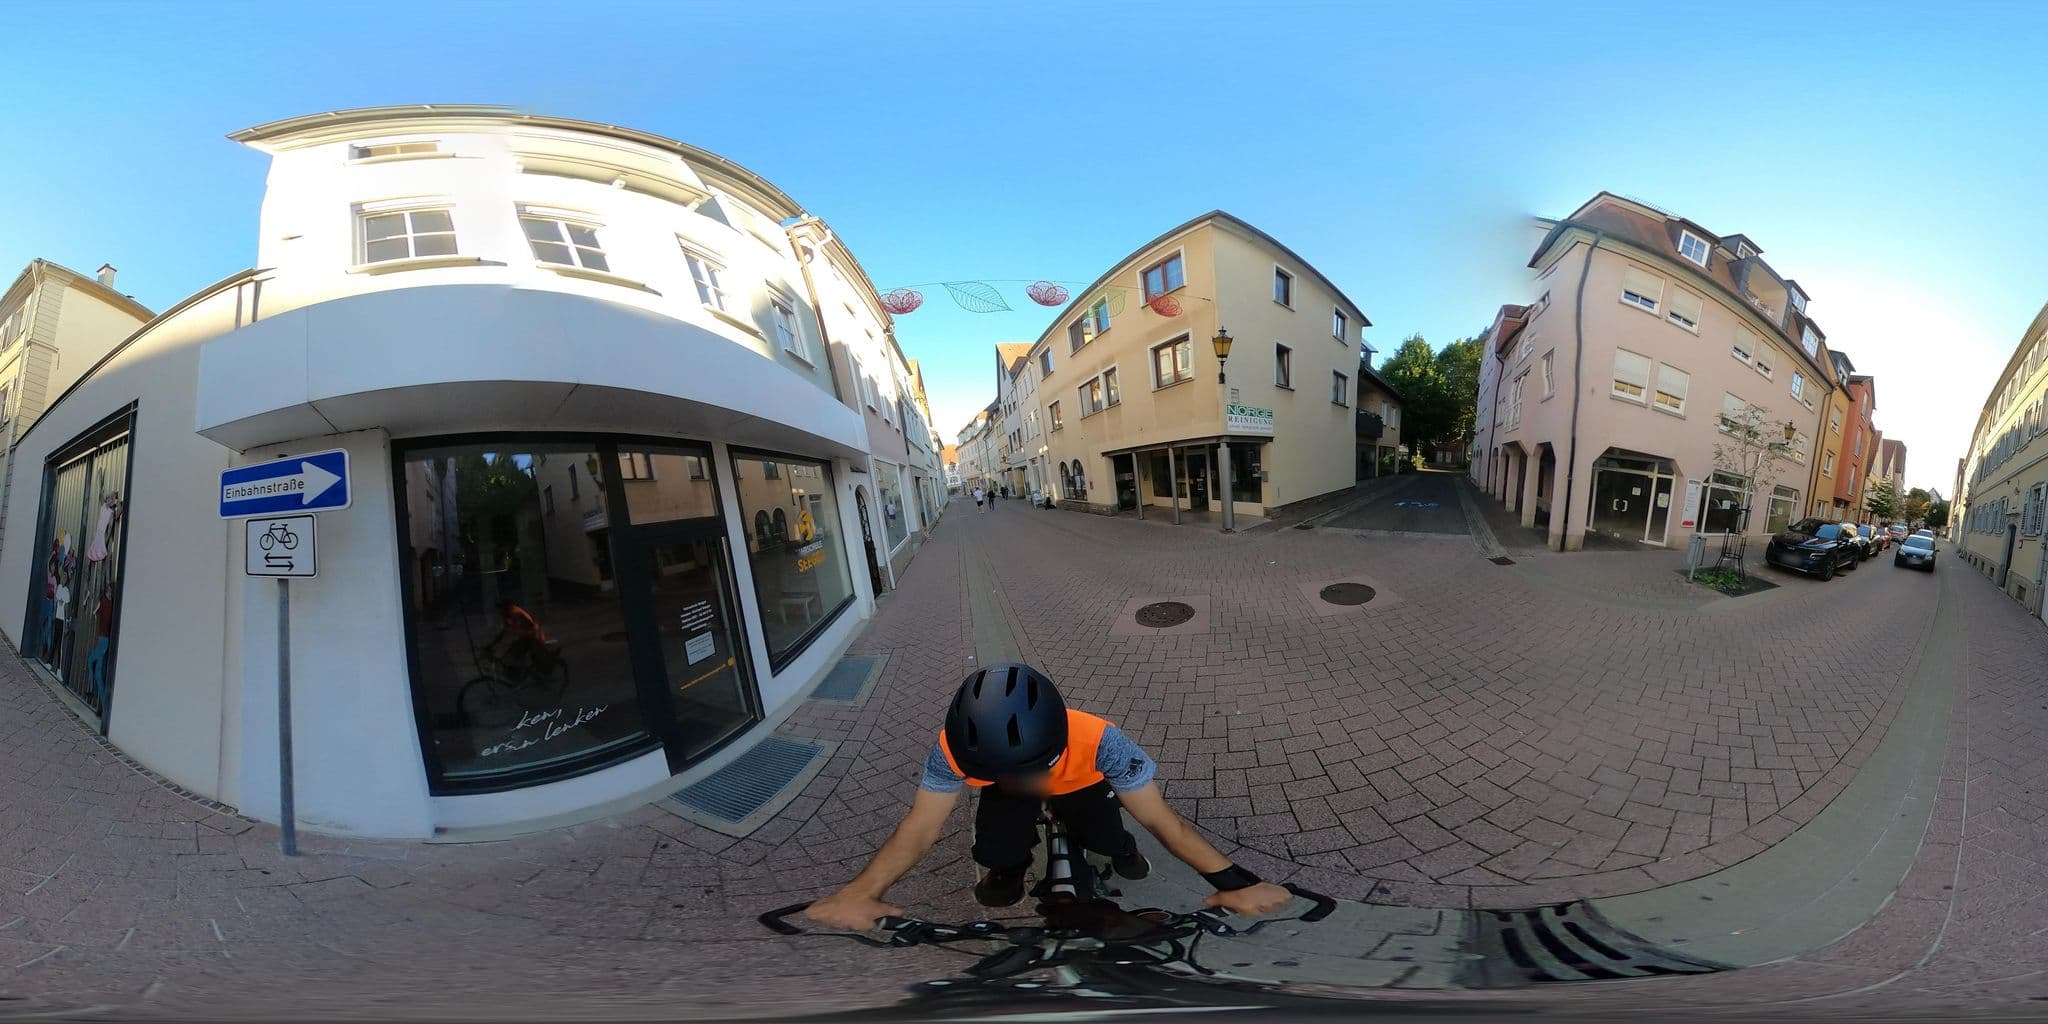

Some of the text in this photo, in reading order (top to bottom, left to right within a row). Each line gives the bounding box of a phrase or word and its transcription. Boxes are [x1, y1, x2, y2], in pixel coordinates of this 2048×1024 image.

[1227, 405, 1273, 419] NORGE
[1228, 415, 1273, 425] REINIGUNG
[225, 478, 305, 499] Einbahnstraße
[544, 704, 609, 741] lenken
